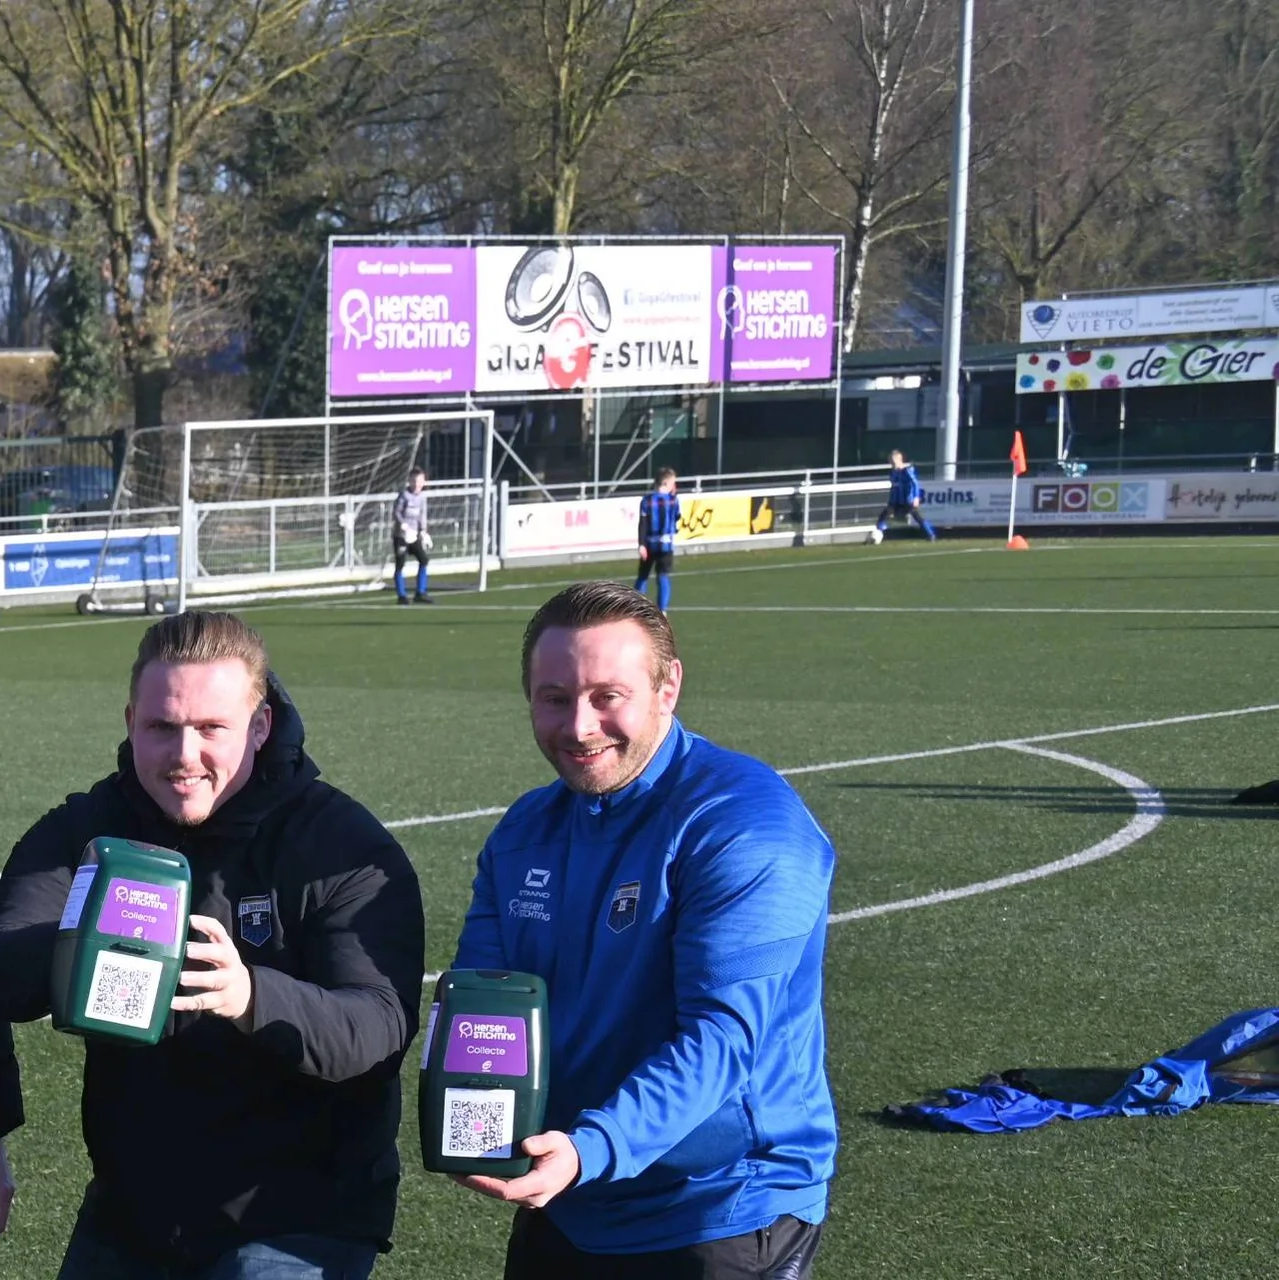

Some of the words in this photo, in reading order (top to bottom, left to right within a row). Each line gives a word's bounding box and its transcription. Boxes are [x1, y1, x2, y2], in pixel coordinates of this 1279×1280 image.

[373, 294, 449, 321] Hersen
[746, 289, 809, 314] Hersen
[1067, 318, 1134, 333] VIETO
[1126, 348, 1167, 380] de
[1180, 344, 1266, 381] Gier
[1037, 485, 1147, 509] FOOX
[121, 909, 157, 924] Collecte
[466, 1045, 506, 1056] Collecte
